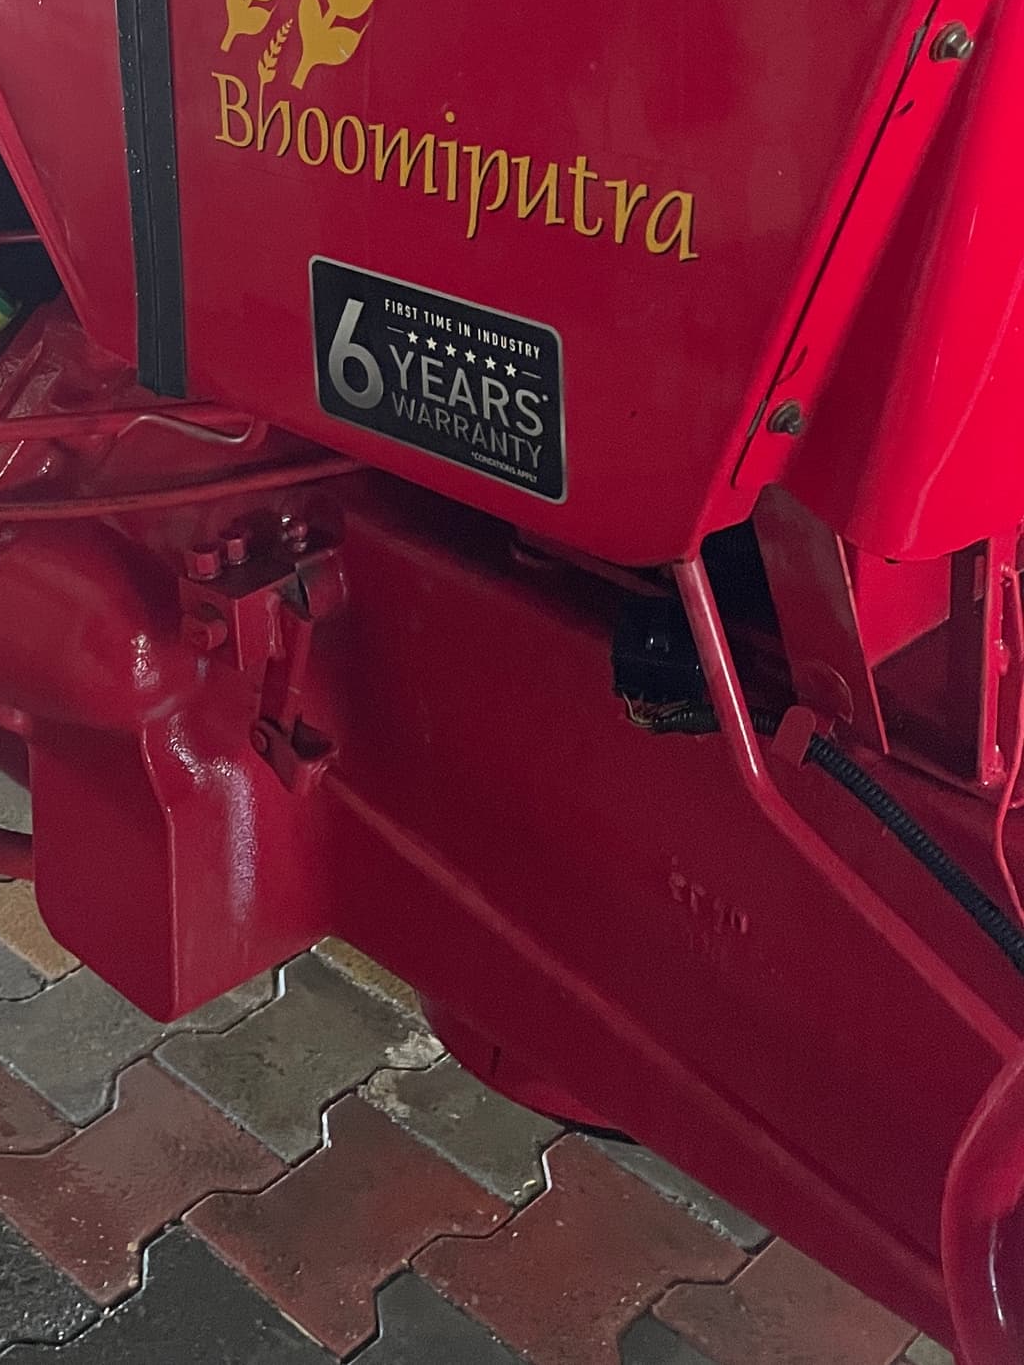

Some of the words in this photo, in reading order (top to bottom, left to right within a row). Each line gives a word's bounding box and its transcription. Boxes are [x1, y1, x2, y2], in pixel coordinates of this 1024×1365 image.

[211, 71, 699, 262] Bhoomiputra
[328, 298, 384, 410] 6
[384, 298, 418, 321] FIRST
[424, 310, 453, 333] TIME
[458, 321, 471, 338] IN
[477, 328, 541, 360] INDUSTRY
[392, 392, 543, 469] WARRANTY
